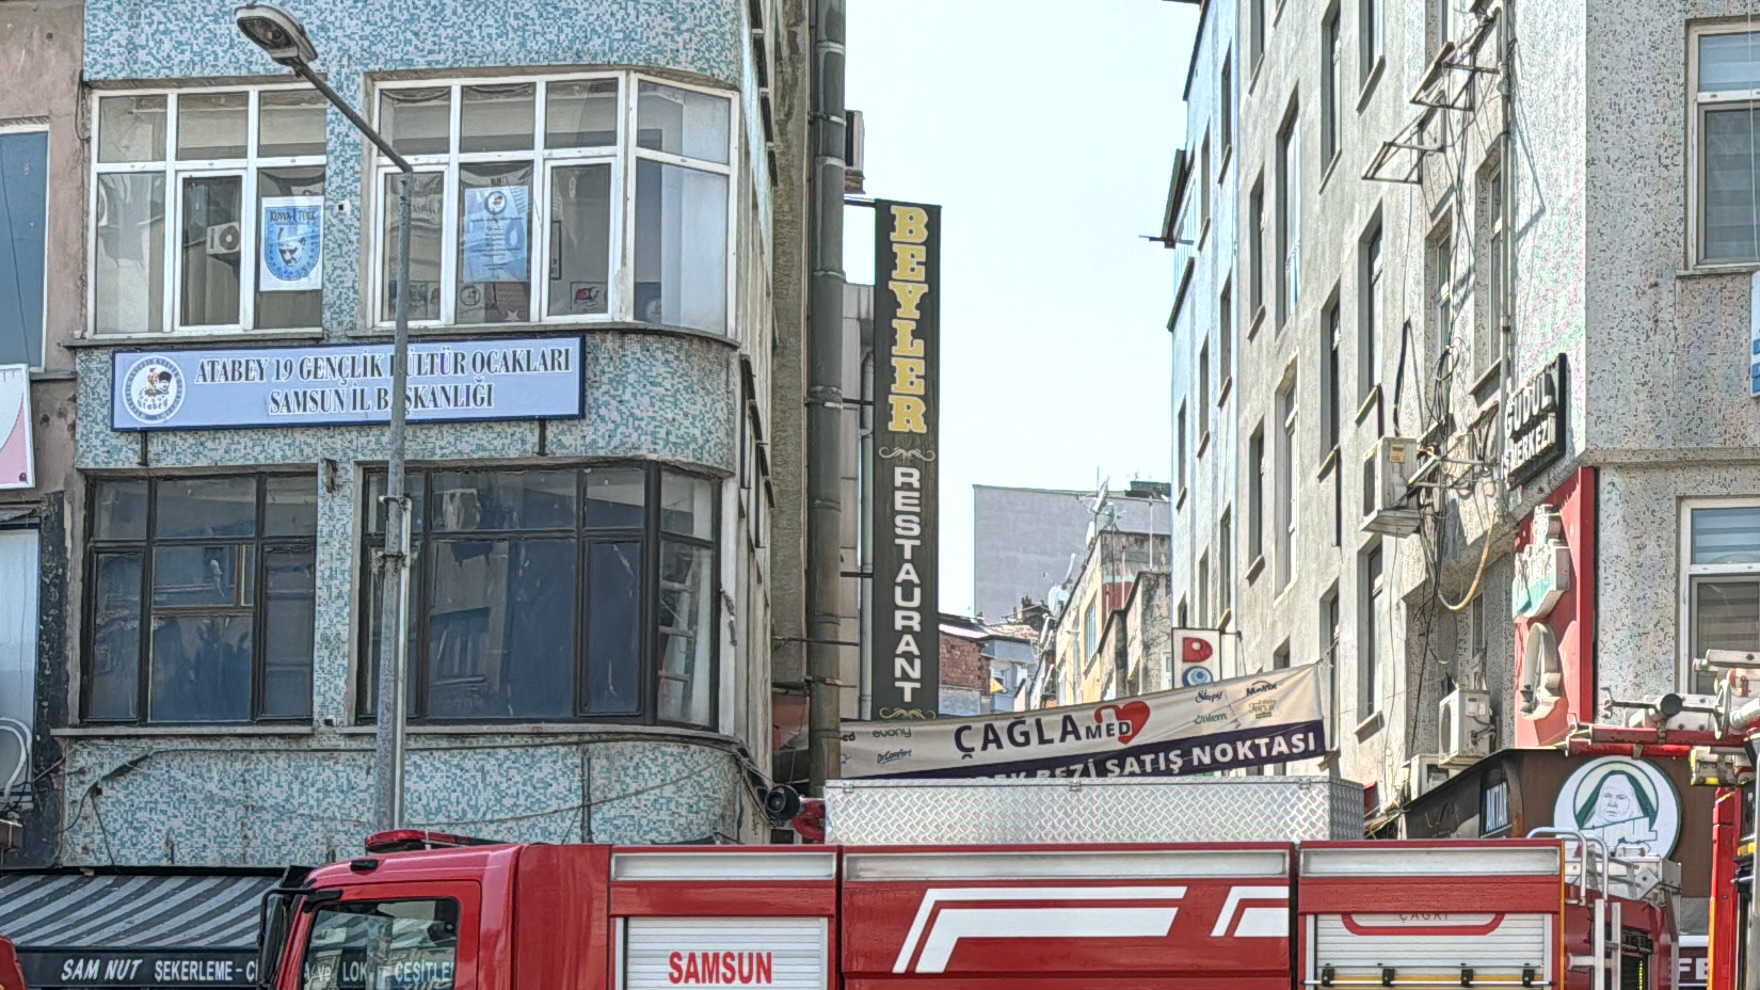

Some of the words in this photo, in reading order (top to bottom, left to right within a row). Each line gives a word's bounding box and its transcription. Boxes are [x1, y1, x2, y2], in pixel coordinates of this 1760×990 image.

[888, 205, 929, 434] BEYLER
[195, 356, 268, 385] ATABEY
[272, 356, 294, 381] 19
[299, 349, 382, 387] GENÇLİK
[470, 346, 572, 377] OCAKLARI
[269, 387, 345, 416] SAMSUN
[349, 382, 371, 412] İL
[376, 381, 495, 416] BŞKANLIĞI
[894, 466, 921, 703] RESTAURANT
[1105, 749, 1184, 777] SATIŞ
[1192, 731, 1315, 767] NOKTASI
[61, 958, 101, 982] SAM
[103, 958, 144, 982] NUT
[668, 951, 773, 985] SAMSUN
